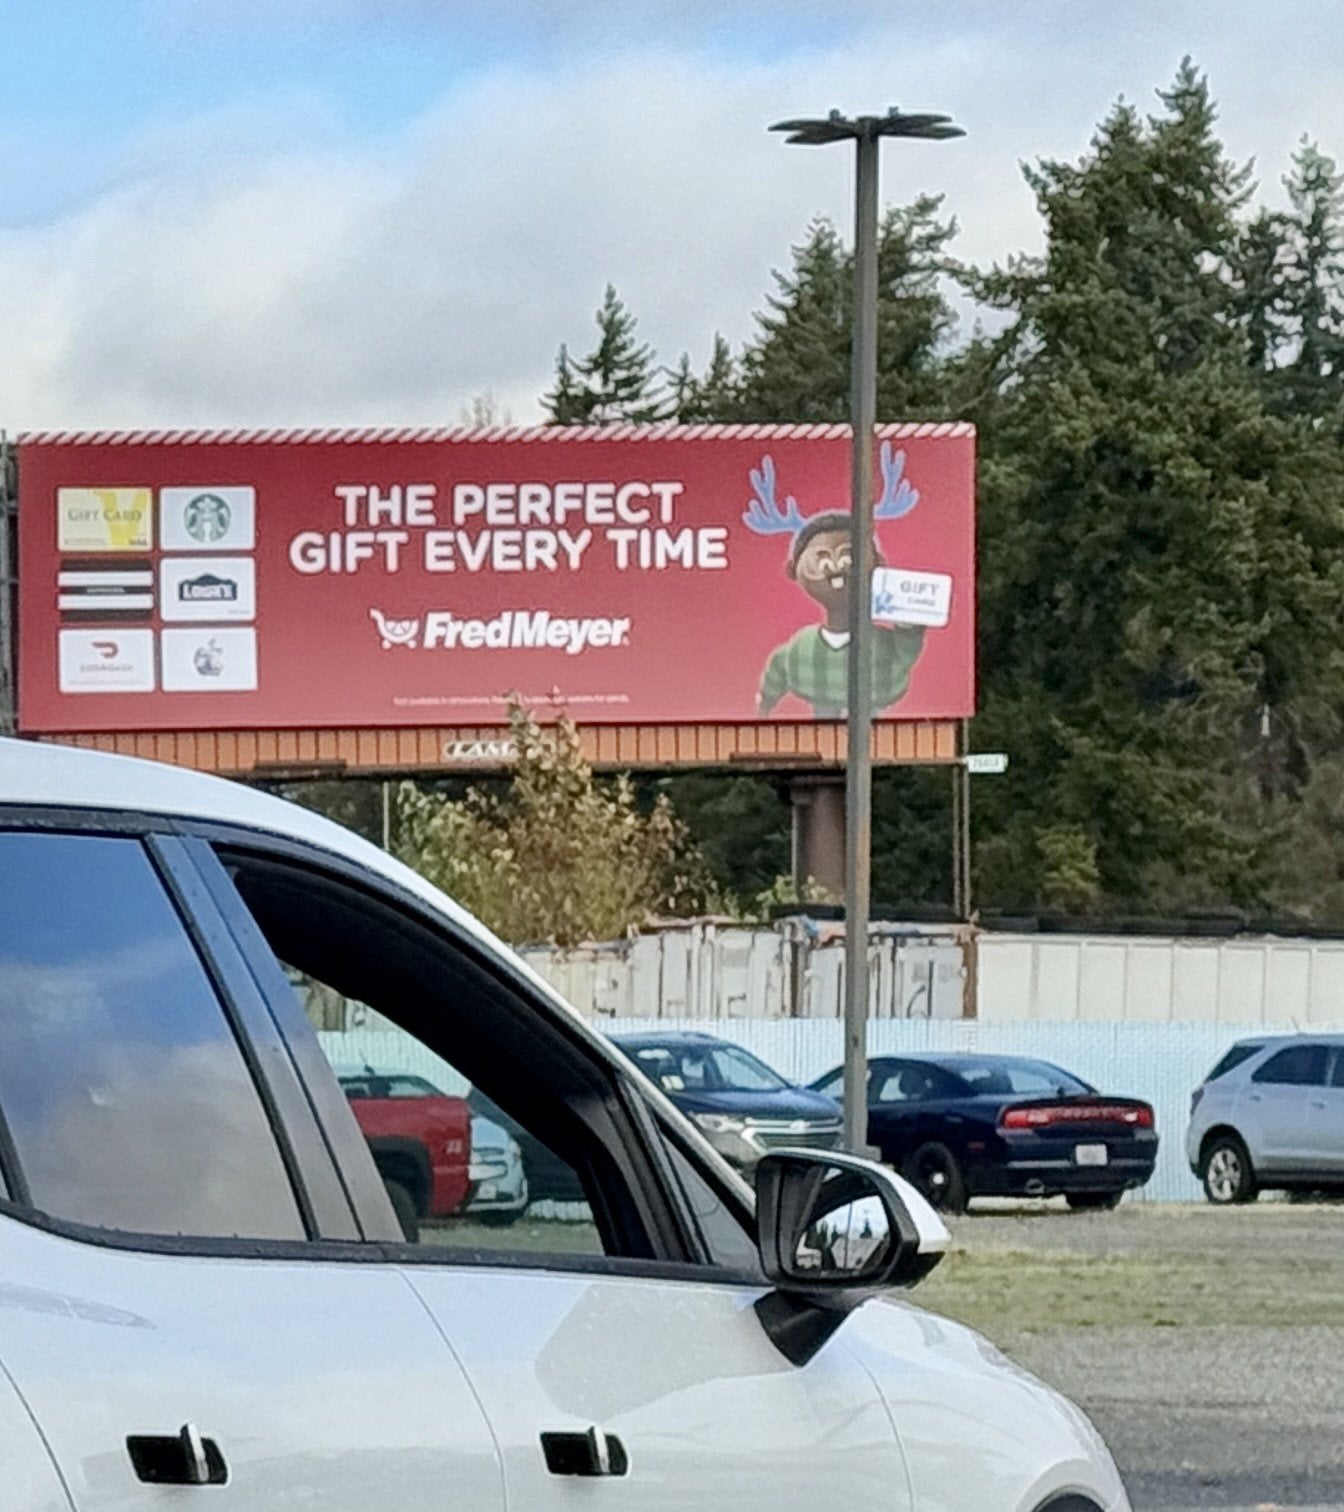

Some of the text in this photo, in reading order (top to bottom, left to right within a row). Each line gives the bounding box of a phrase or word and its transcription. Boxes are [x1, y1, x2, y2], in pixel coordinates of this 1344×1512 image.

[335, 482, 684, 526] THE PERFECT
[289, 527, 728, 573] GIFT EVERY TIME
[900, 580, 939, 596] GIFT
